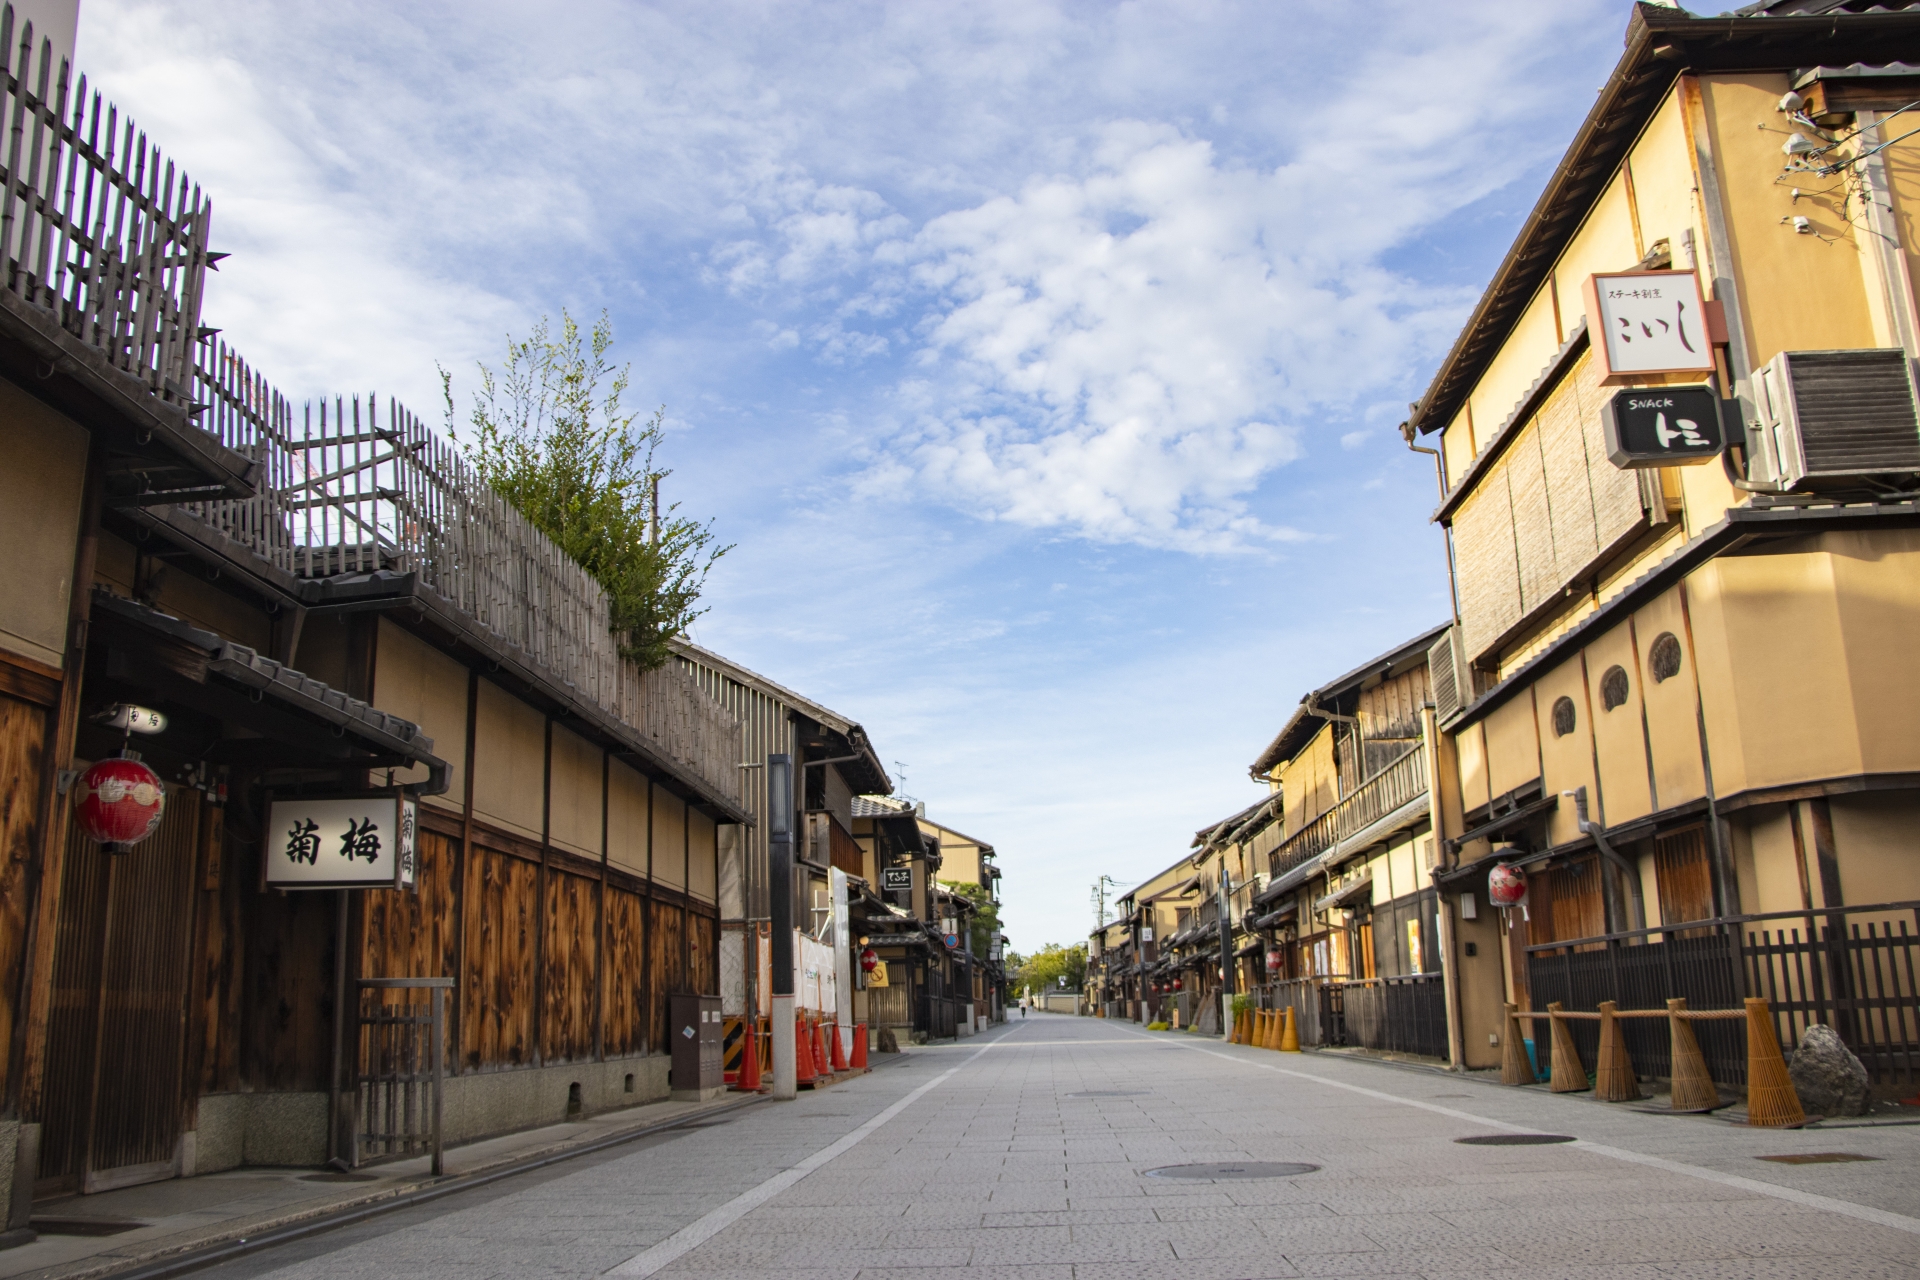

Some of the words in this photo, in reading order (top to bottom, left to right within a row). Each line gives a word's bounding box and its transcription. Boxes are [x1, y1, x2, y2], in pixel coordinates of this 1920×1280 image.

[1608, 289, 1662, 299] ステーキ割烹
[1618, 300, 1695, 353] こいし
[1629, 398, 1673, 410] SNACK
[1656, 412, 1710, 448] トミ
[285, 817, 381, 865] 菊梅
